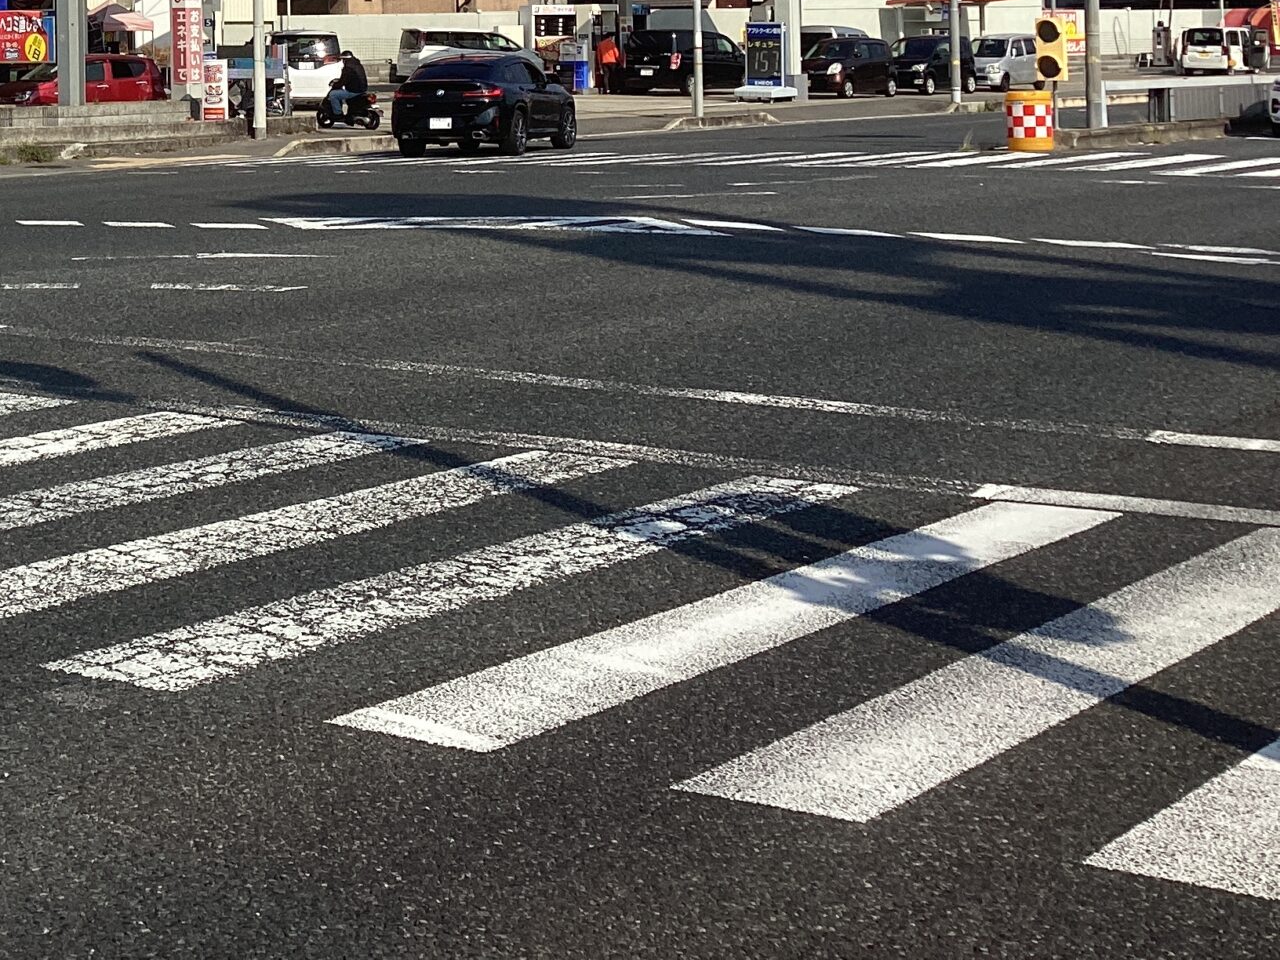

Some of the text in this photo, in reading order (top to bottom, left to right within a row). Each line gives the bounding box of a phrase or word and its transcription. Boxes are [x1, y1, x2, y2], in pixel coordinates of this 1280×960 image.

[177, 10, 187, 81] エネキーで
[190, 10, 201, 81] お支払いは
[205, 18, 211, 27] 5
[755, 50, 780, 72] 157
